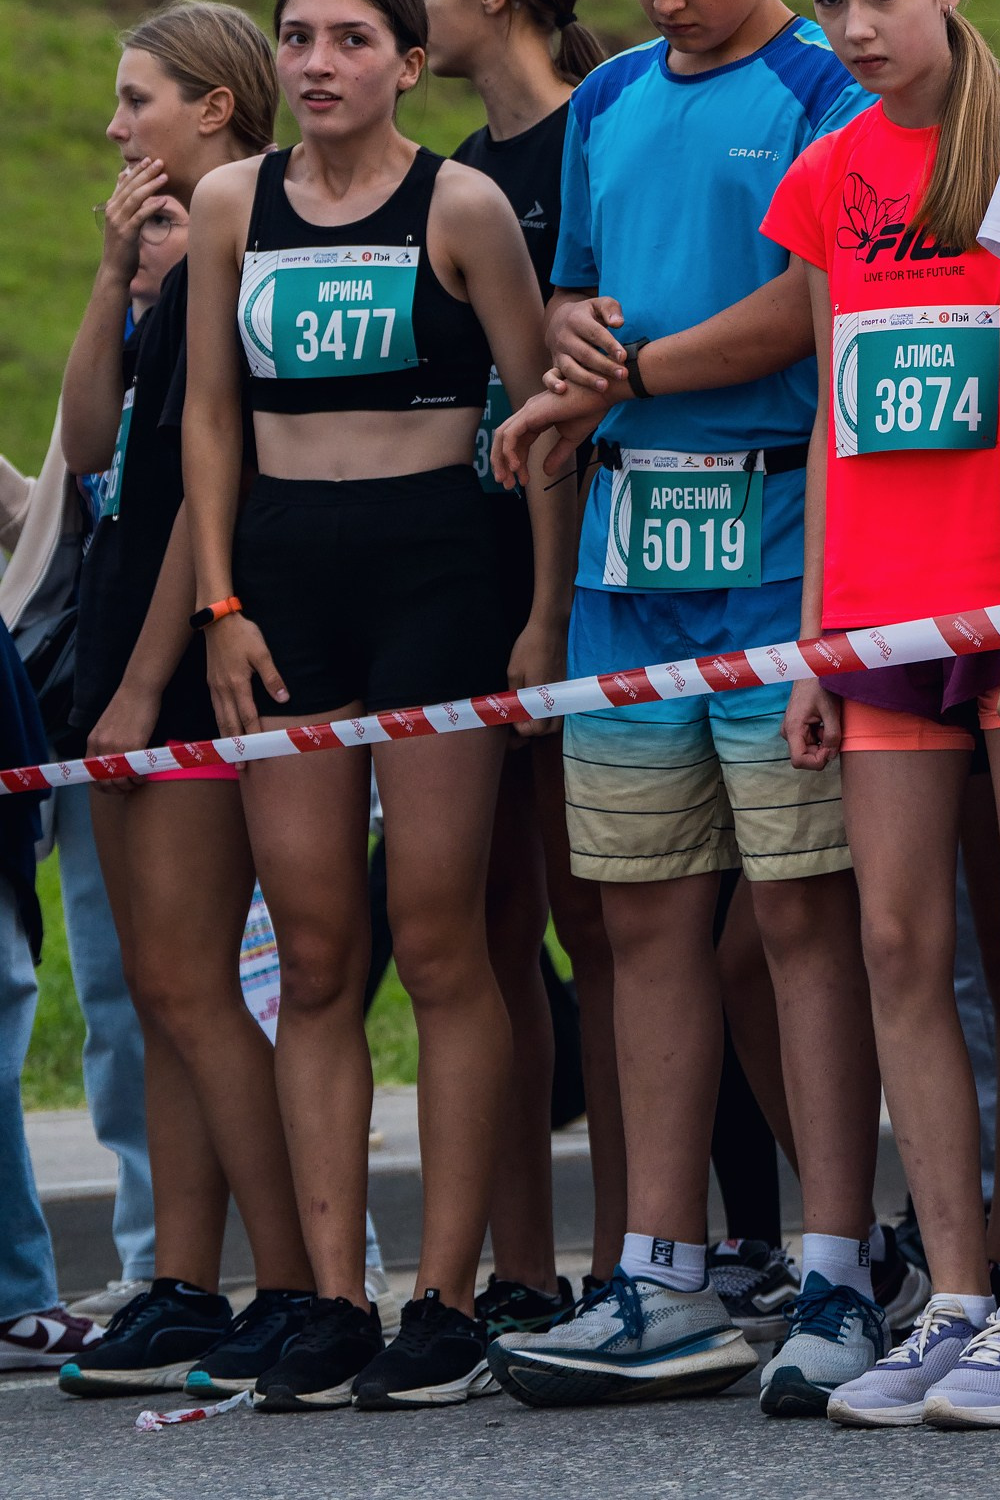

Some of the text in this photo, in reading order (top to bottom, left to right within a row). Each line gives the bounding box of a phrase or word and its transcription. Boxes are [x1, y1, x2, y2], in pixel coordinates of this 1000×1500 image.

[728, 148, 772, 159] CRAFT
[374, 252, 390, 262] Пэй
[864, 266, 965, 282] LIVE FOR THE FUTURE
[318, 280, 373, 302] ИРИНА
[952, 312, 969, 322] Пэй
[296, 308, 396, 362] 3477
[894, 344, 955, 368] АЛИСА
[422, 395, 456, 404] DEMIX
[875, 376, 982, 433] 3874
[716, 457, 734, 467] Пэй
[651, 484, 732, 510] АРСЕНИЙ
[642, 518, 746, 572] 5019
[873, 635, 892, 655] СПОРТ
[973, 638, 981, 647] НЕ
[769, 652, 787, 671] СПОРТ
[832, 659, 840, 668] НЕ
[629, 690, 637, 699] НЕ
[654, 1240, 672, 1264] MEN
[860, 1242, 869, 1266] MEN
